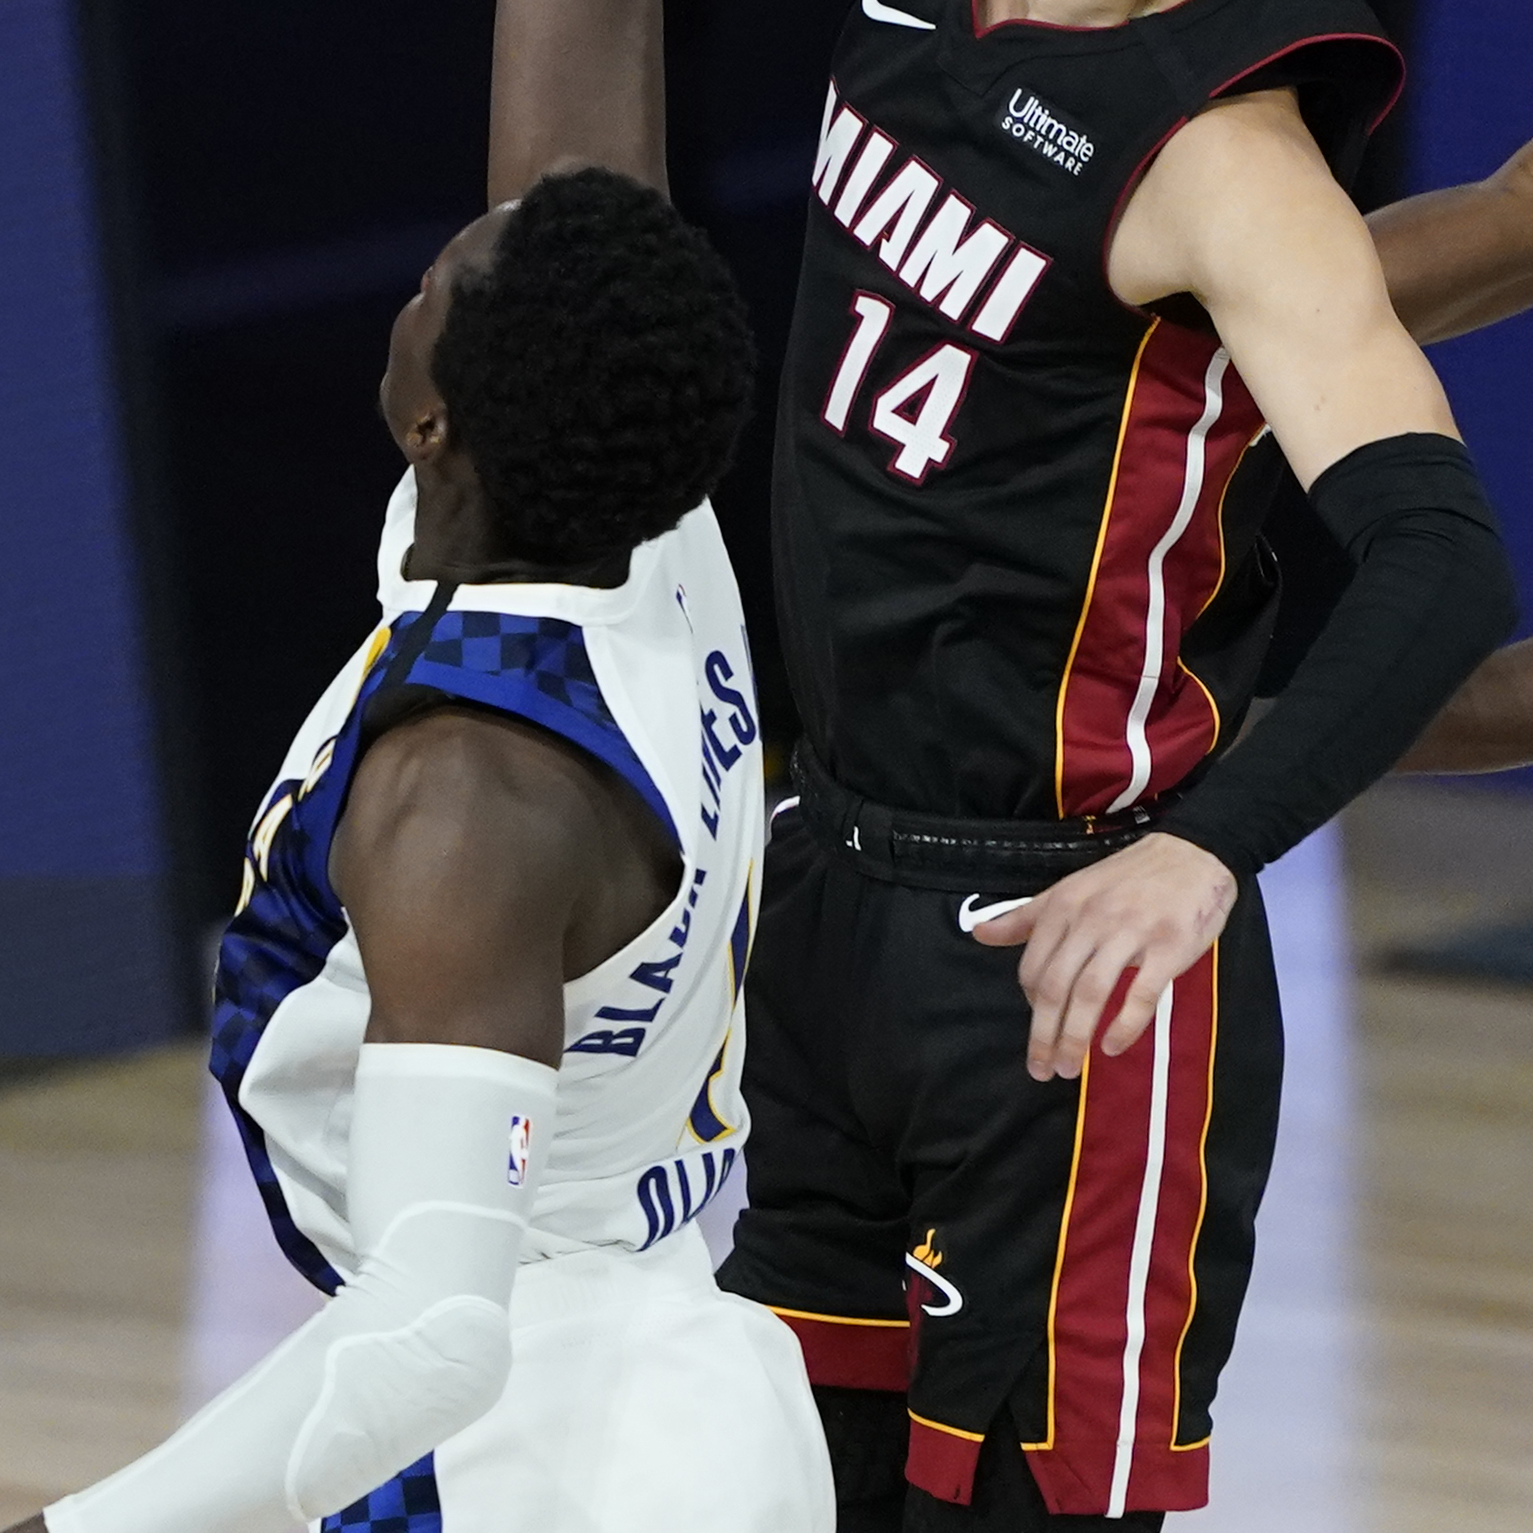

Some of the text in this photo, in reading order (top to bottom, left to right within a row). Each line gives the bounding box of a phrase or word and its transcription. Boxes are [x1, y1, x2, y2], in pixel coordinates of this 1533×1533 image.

[812, 74, 1053, 343] MIAMI
[1001, 115, 1083, 177] SOFTWARE
[1008, 87, 1095, 163] Ultimate
[820, 288, 979, 487] 14
[564, 868, 707, 1058] BLA
